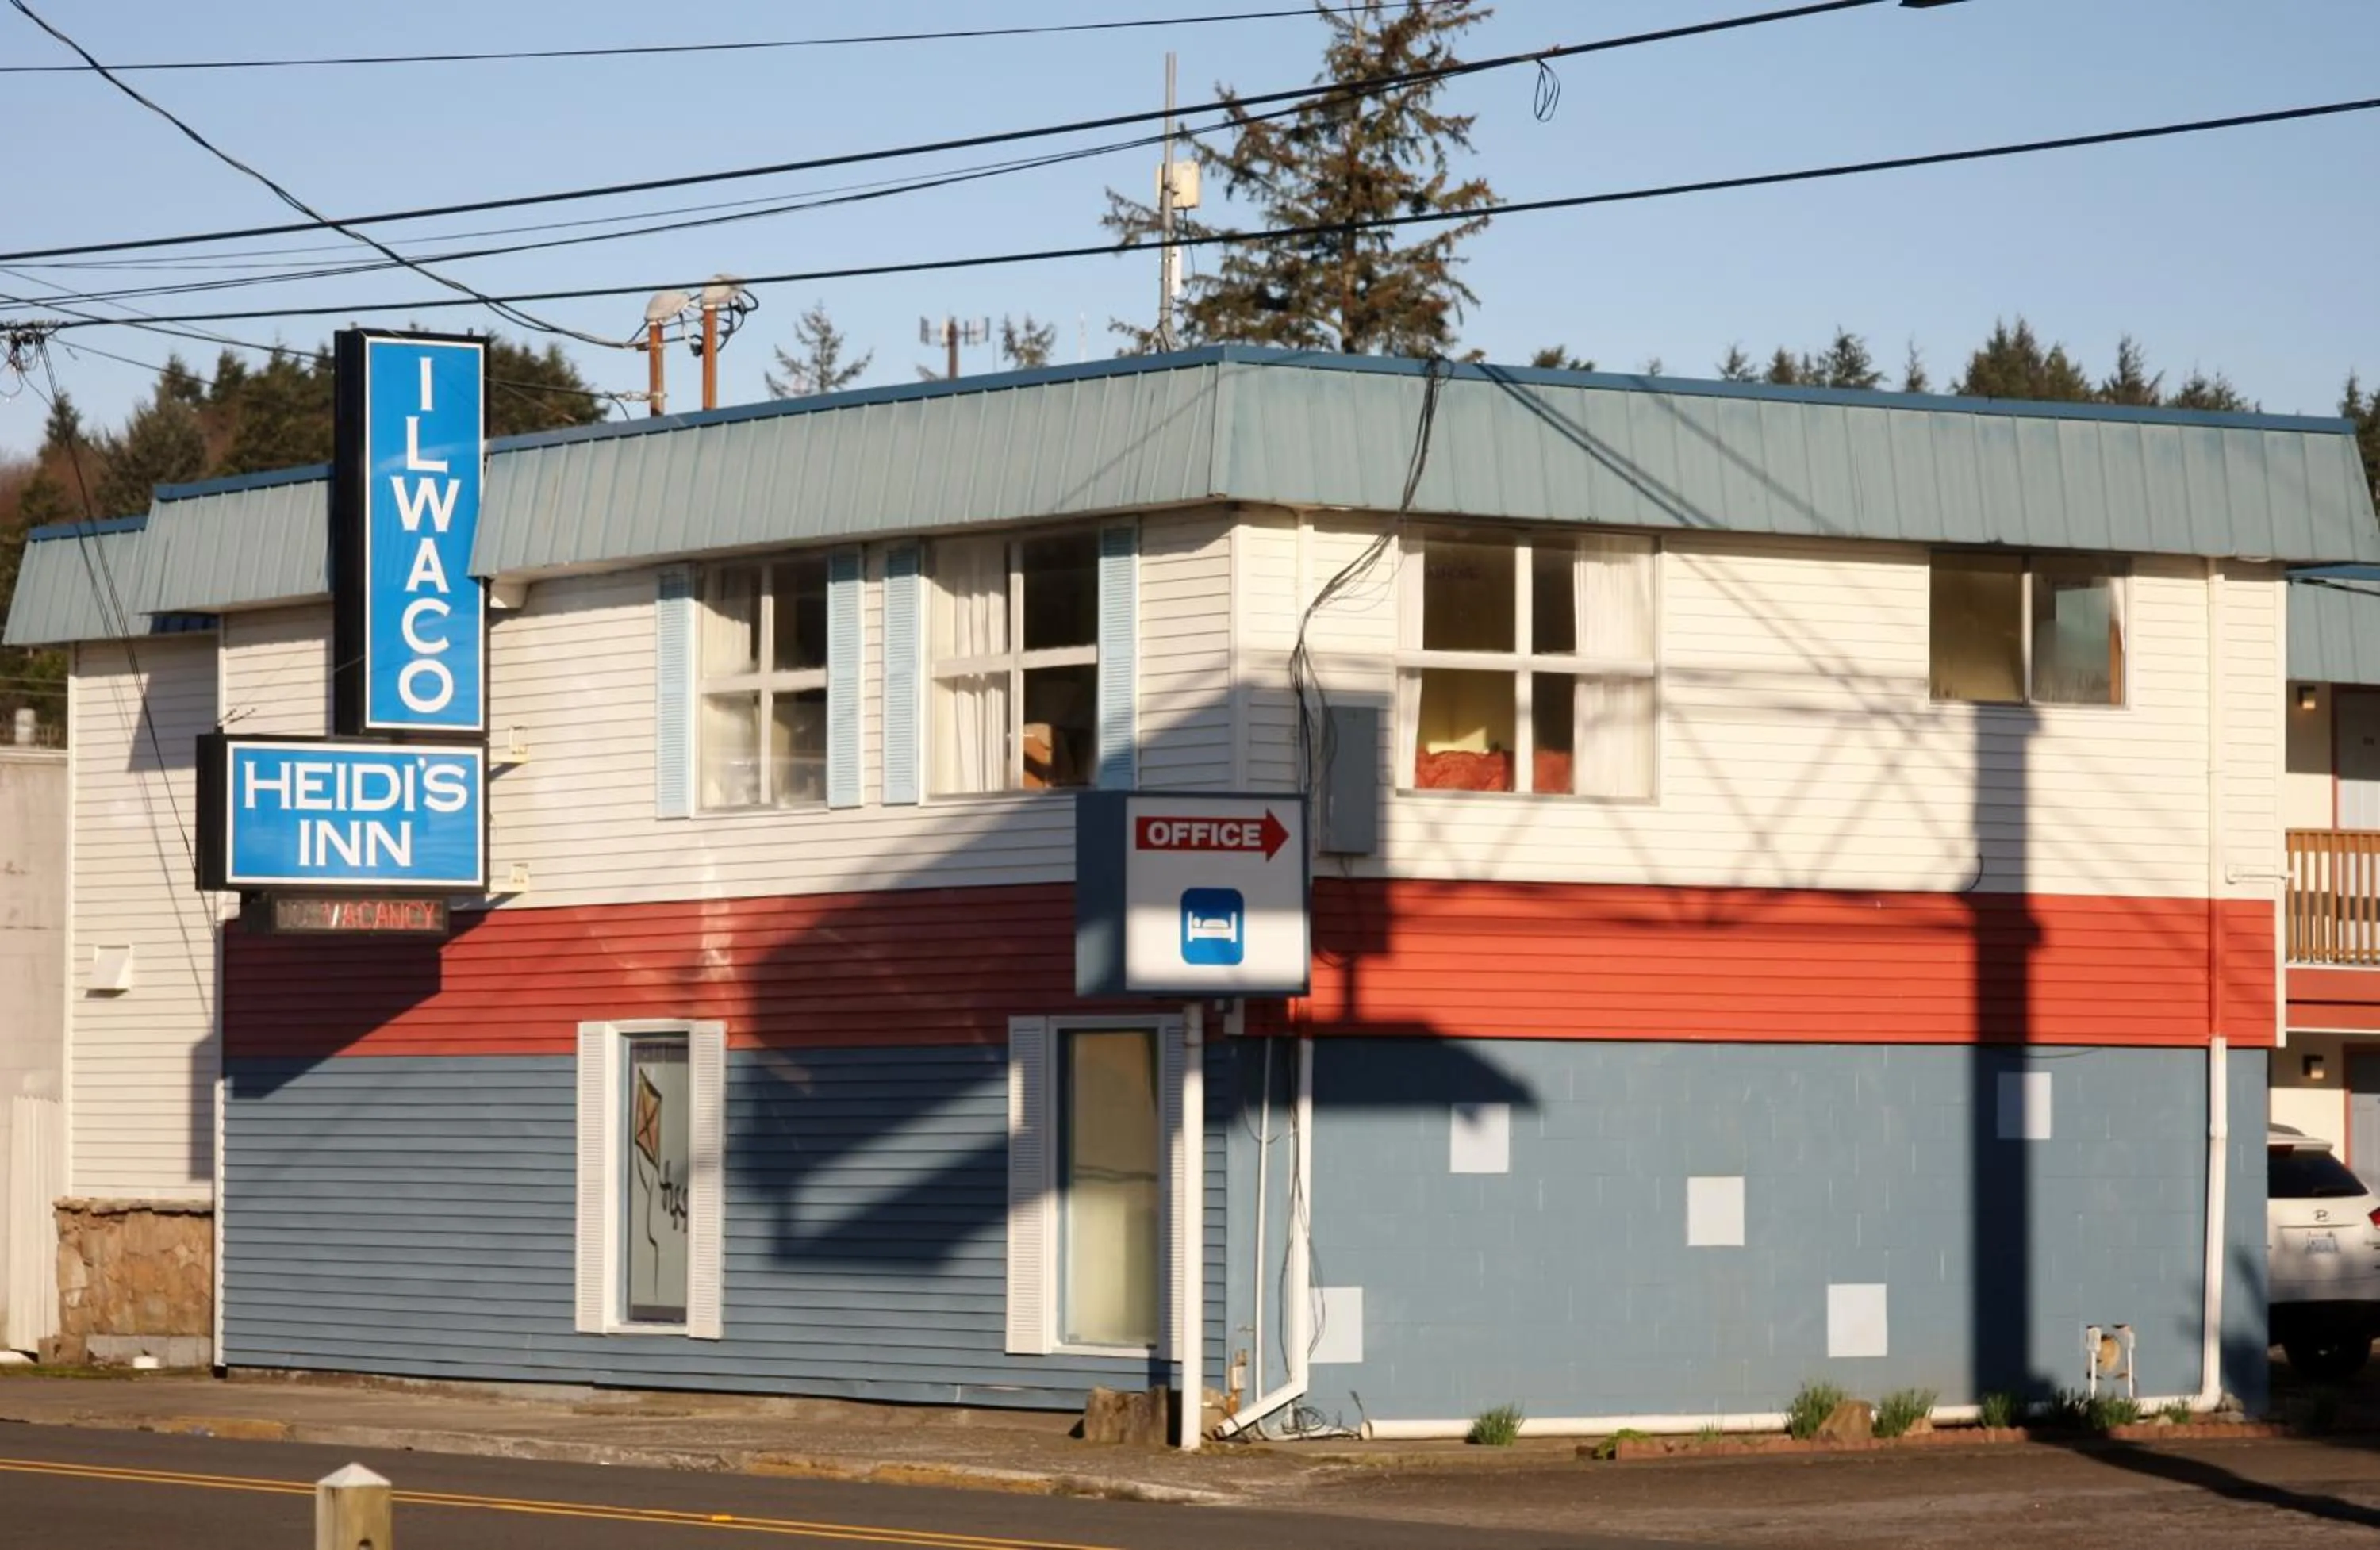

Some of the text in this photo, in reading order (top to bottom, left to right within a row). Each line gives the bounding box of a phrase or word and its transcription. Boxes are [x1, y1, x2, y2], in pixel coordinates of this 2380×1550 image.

[390, 357, 461, 714] ILWACO
[243, 756, 468, 813] HEIDI'S
[298, 819, 412, 868] INN
[1146, 821, 1262, 847] OFFICE
[320, 900, 436, 930] VACANCY
